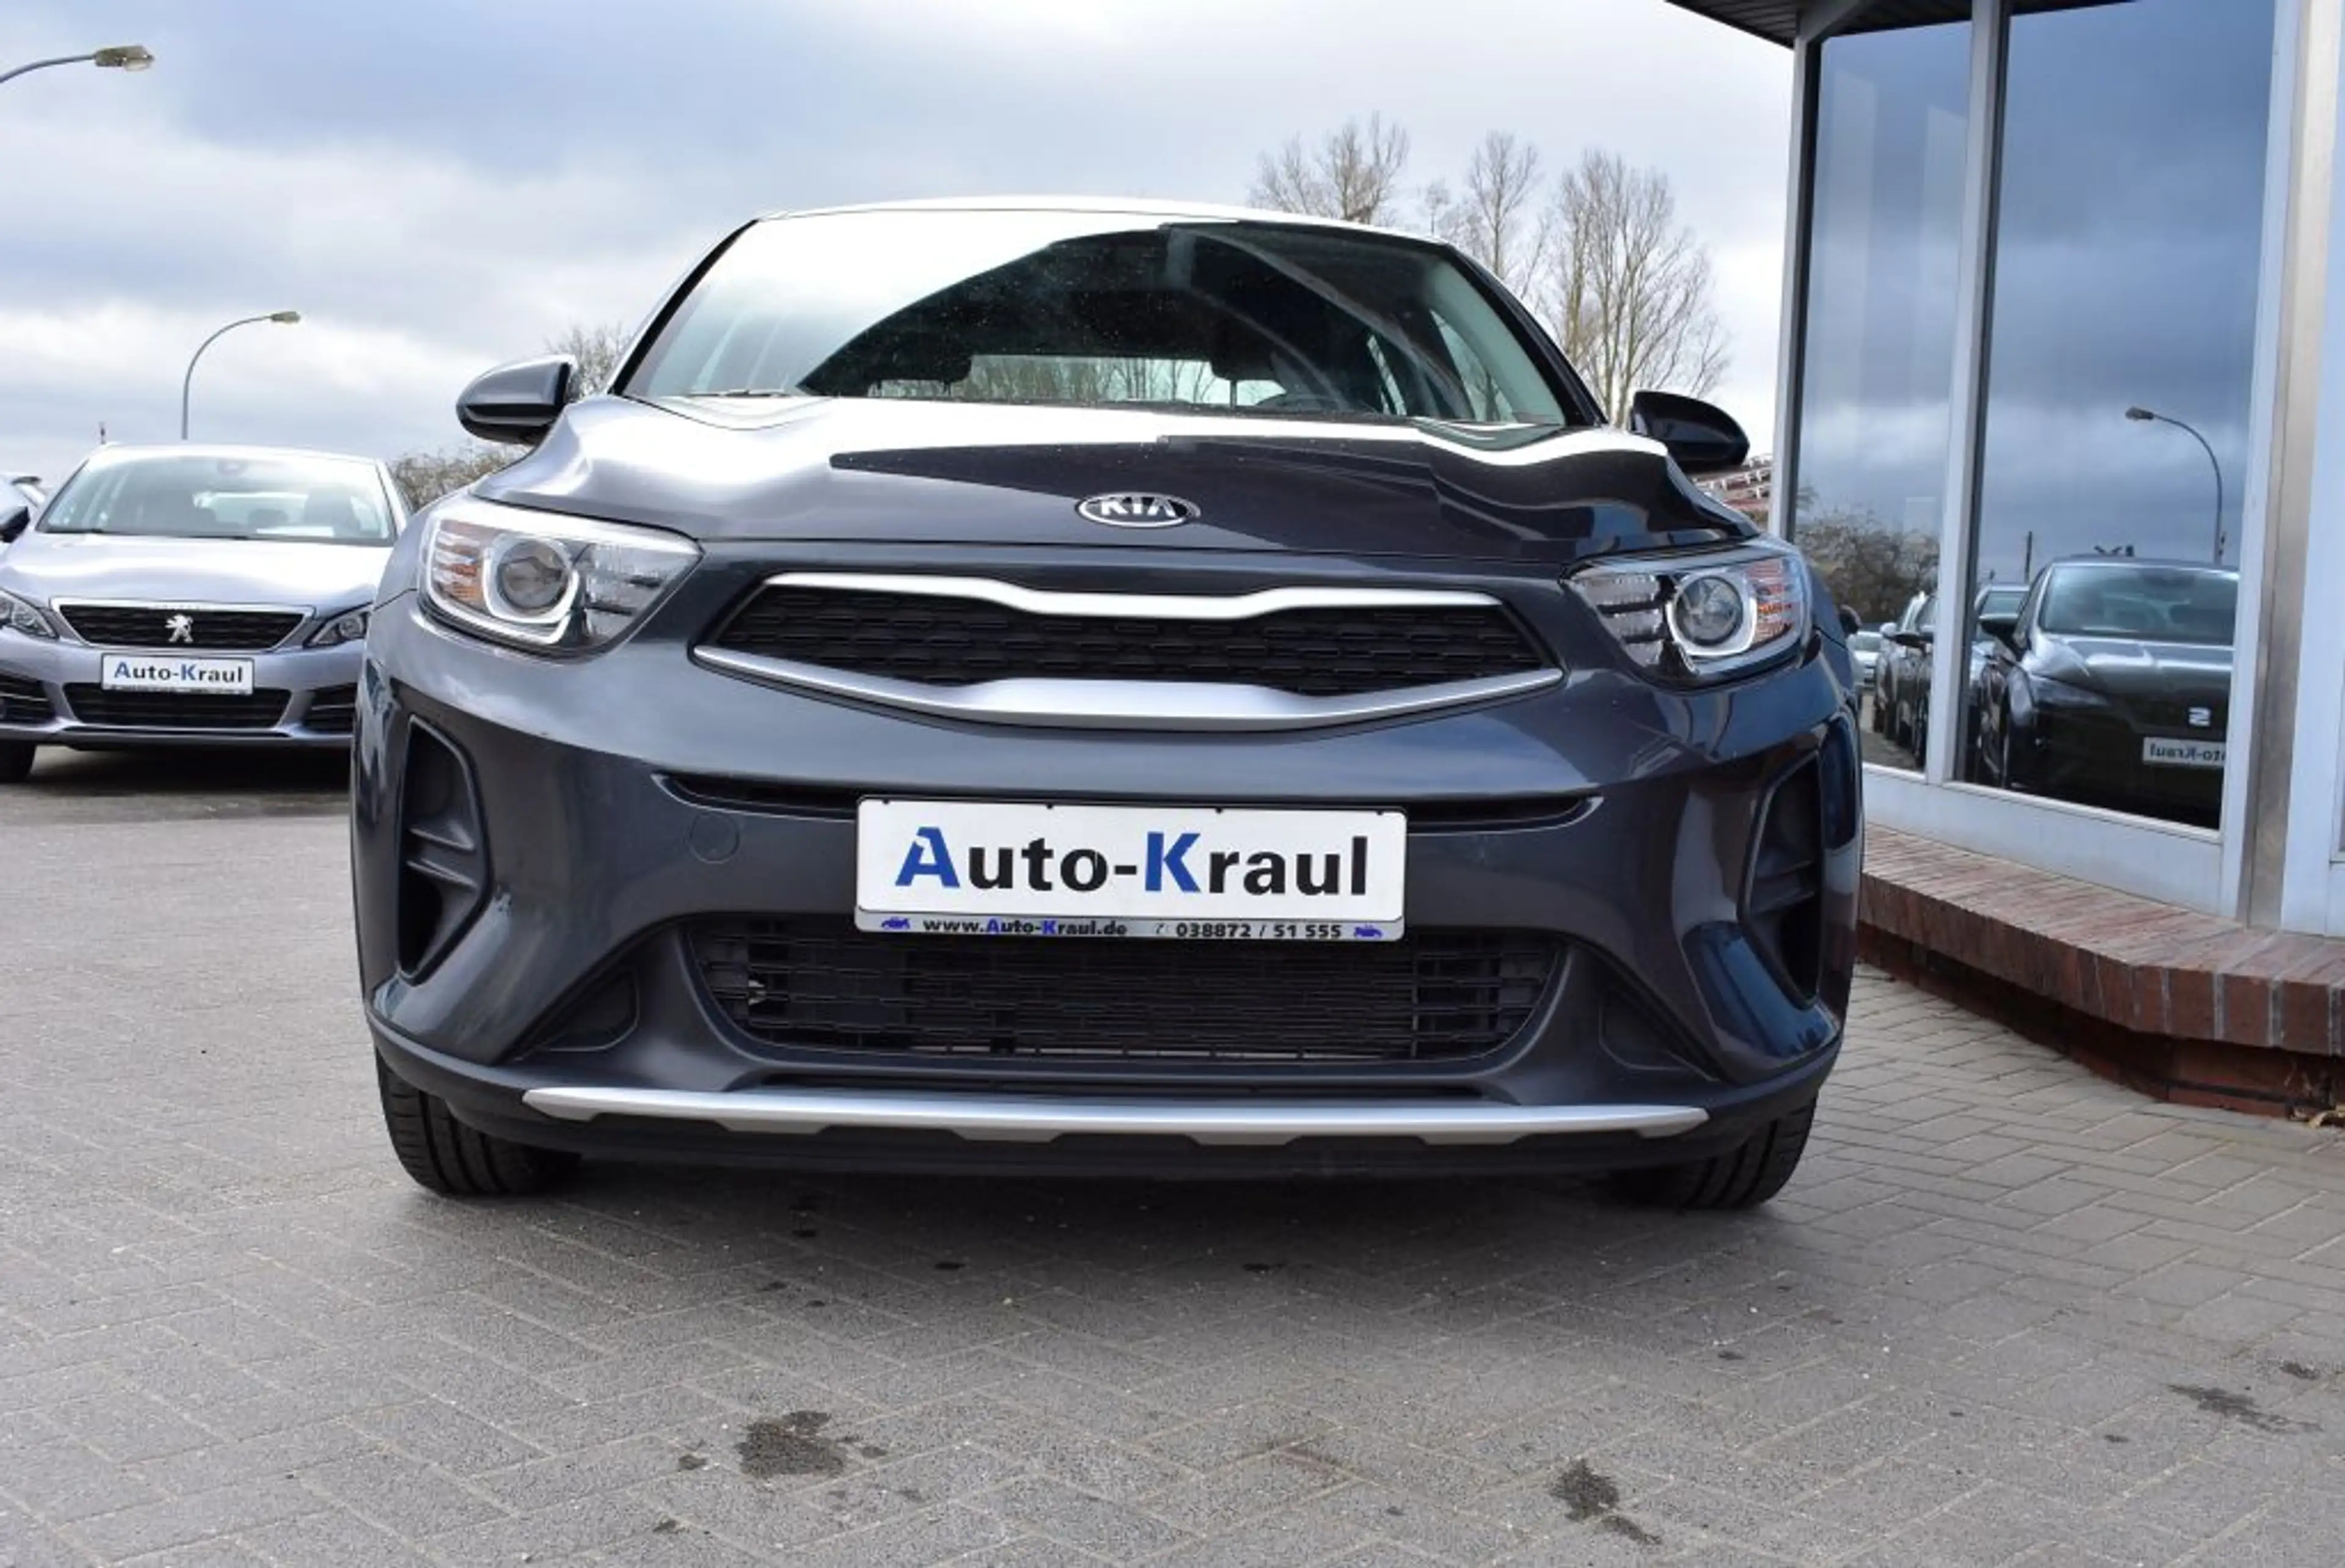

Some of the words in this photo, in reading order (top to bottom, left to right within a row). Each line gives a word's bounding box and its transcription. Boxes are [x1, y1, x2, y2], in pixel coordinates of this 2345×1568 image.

[114, 661, 243, 683] Auto-Kraul
[895, 826, 1368, 896] Auto-Kraul
[923, 917, 1127, 937] www.Auto-Kraul.de
[1176, 923, 1251, 938] 038872
[1273, 924, 1297, 938] 51
[1305, 924, 1342, 939] 555
